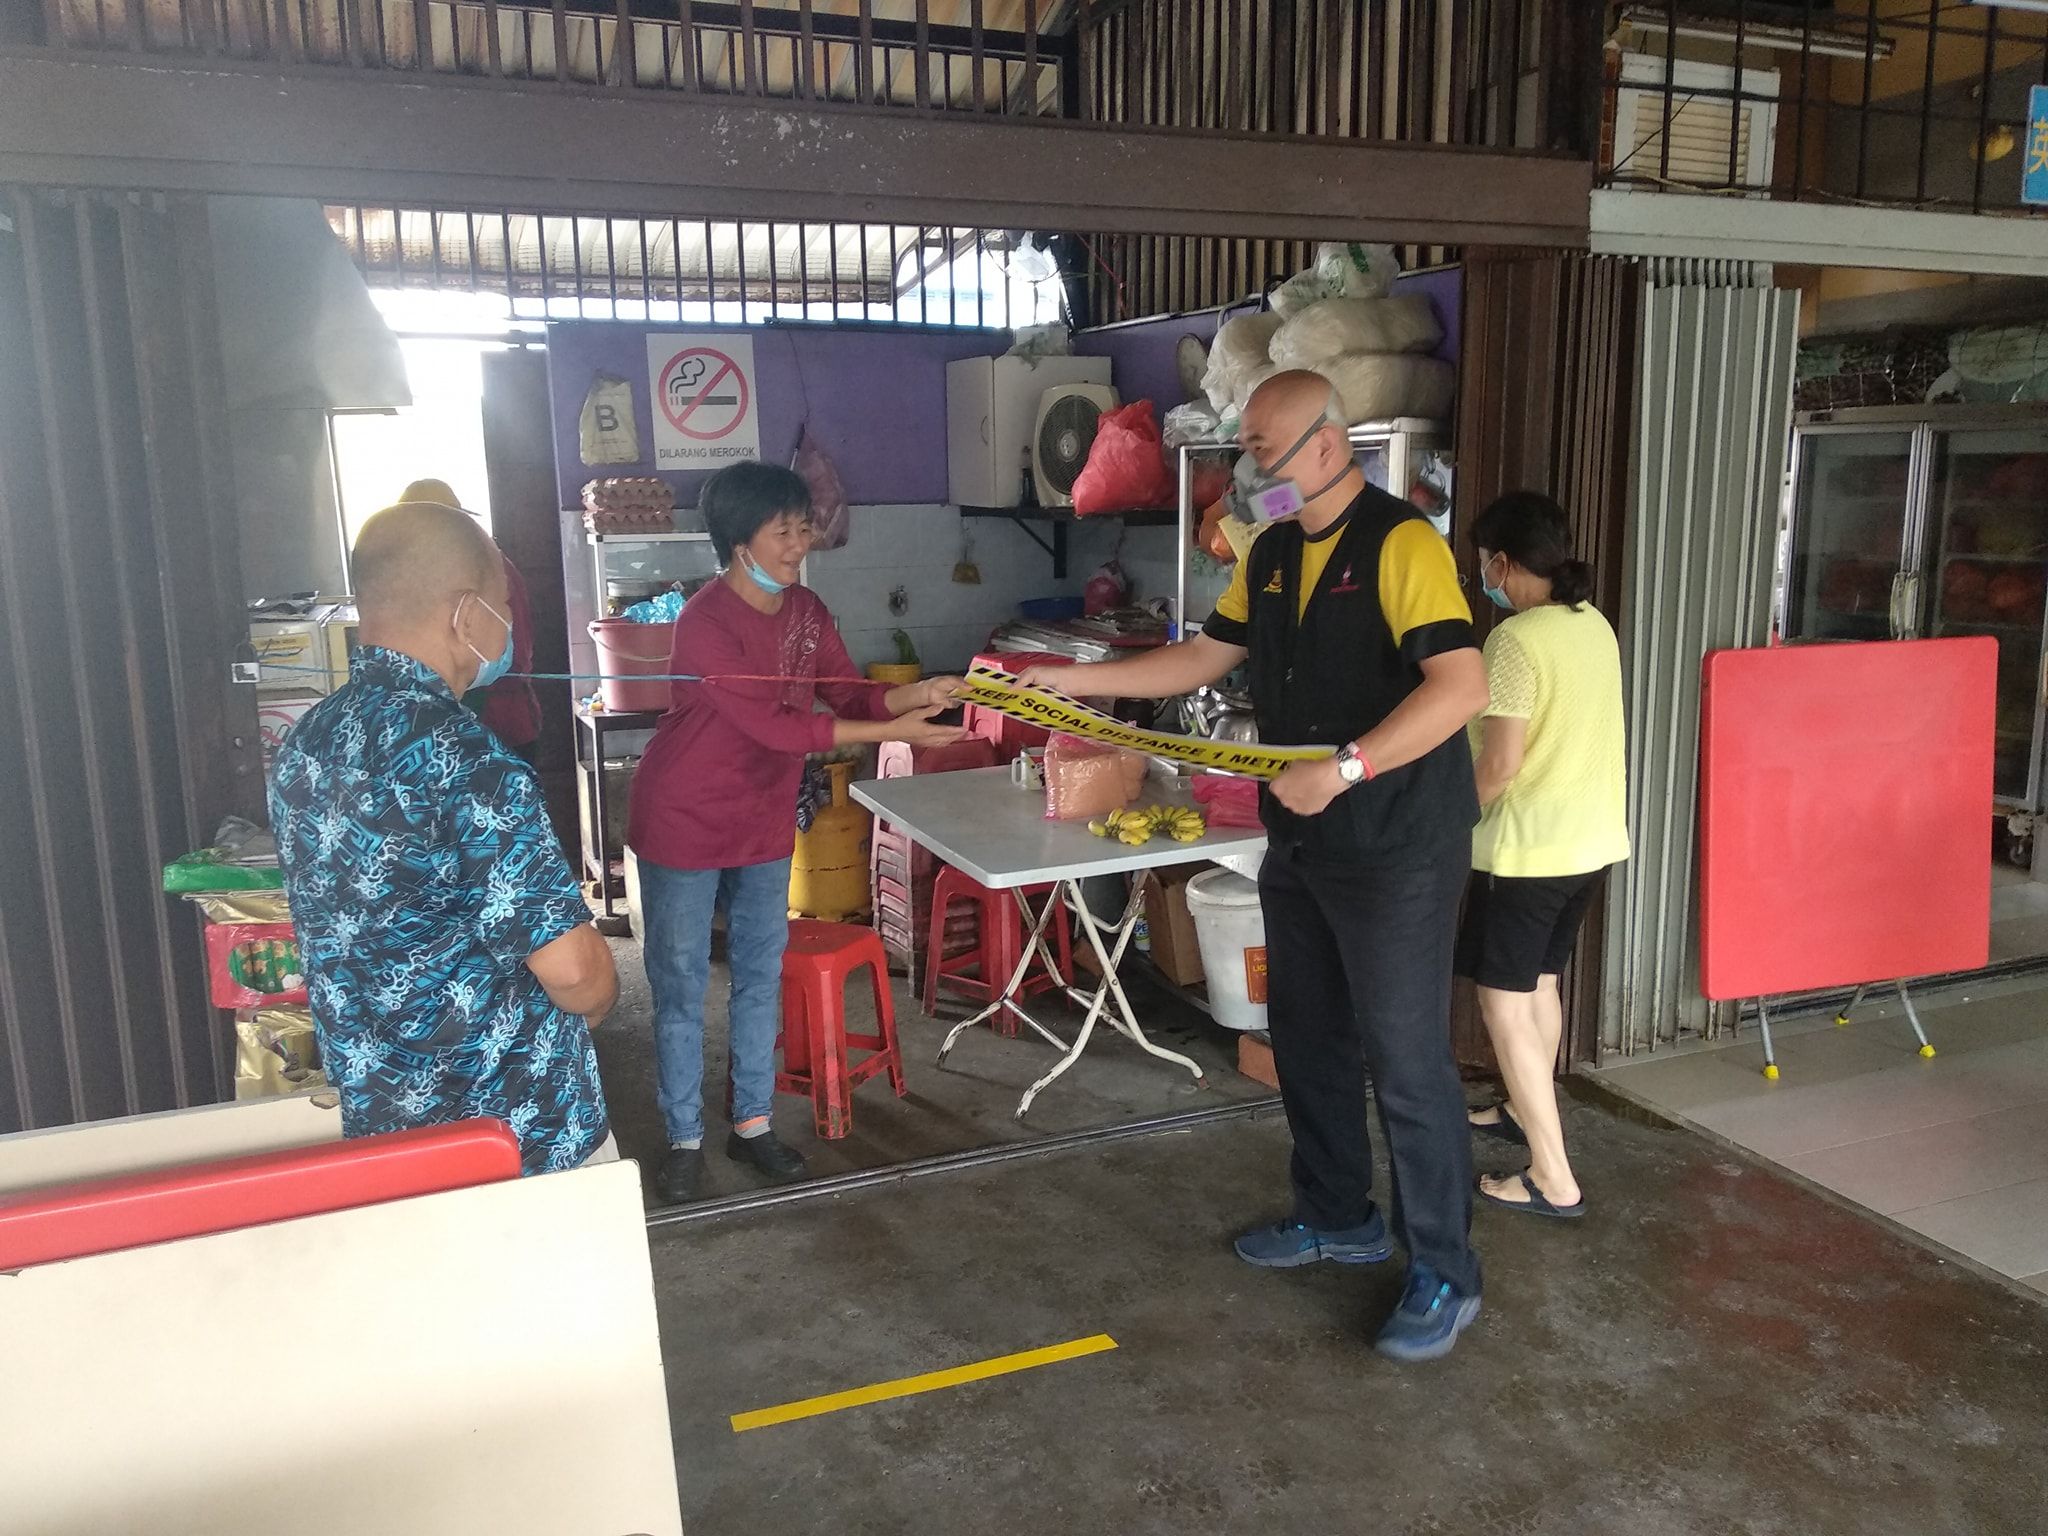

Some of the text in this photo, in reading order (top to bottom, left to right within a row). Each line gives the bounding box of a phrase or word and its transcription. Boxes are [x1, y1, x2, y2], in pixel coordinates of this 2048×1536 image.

[595, 405, 619, 432] B
[659, 446, 756, 458] DILARANG MEROKOK
[971, 686, 1018, 701] KEEP
[1020, 697, 1091, 730] SOCIAL
[1097, 728, 1206, 755] DISTANCE
[1213, 751, 1224, 760] 1
